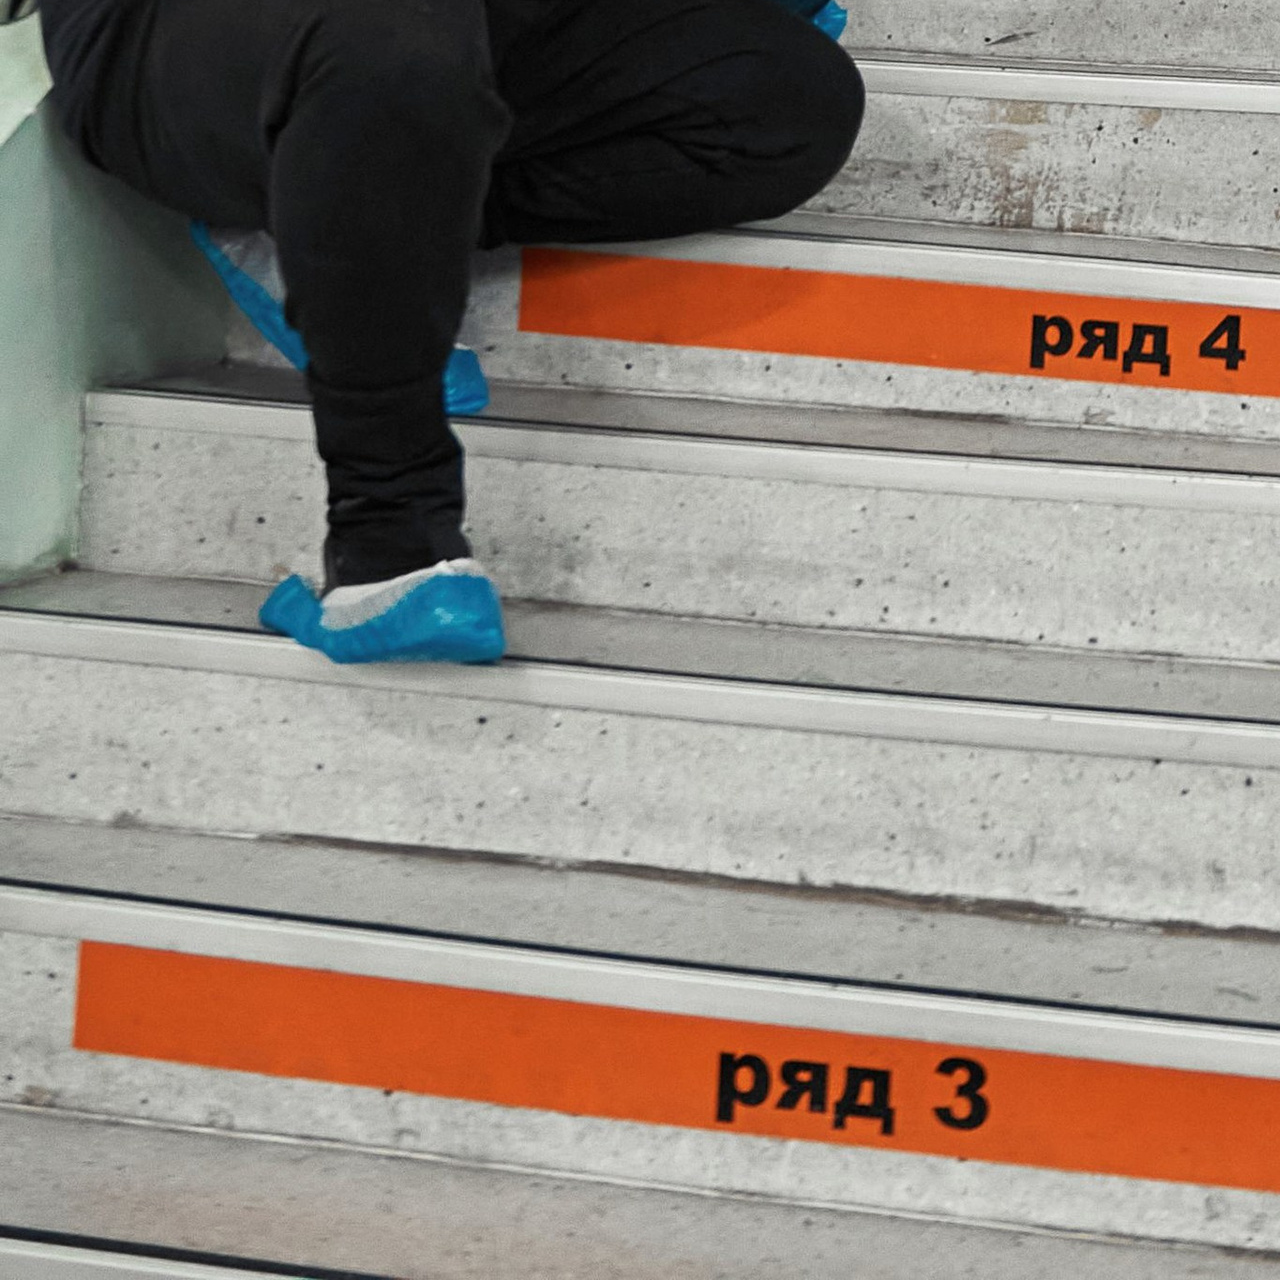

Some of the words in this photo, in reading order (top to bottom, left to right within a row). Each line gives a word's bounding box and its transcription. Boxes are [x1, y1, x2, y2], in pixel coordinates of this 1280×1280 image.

[1030, 315, 1172, 378] ряд
[1199, 315, 1247, 371] 4
[716, 1052, 895, 1136] ряд
[934, 1057, 989, 1131] 3
